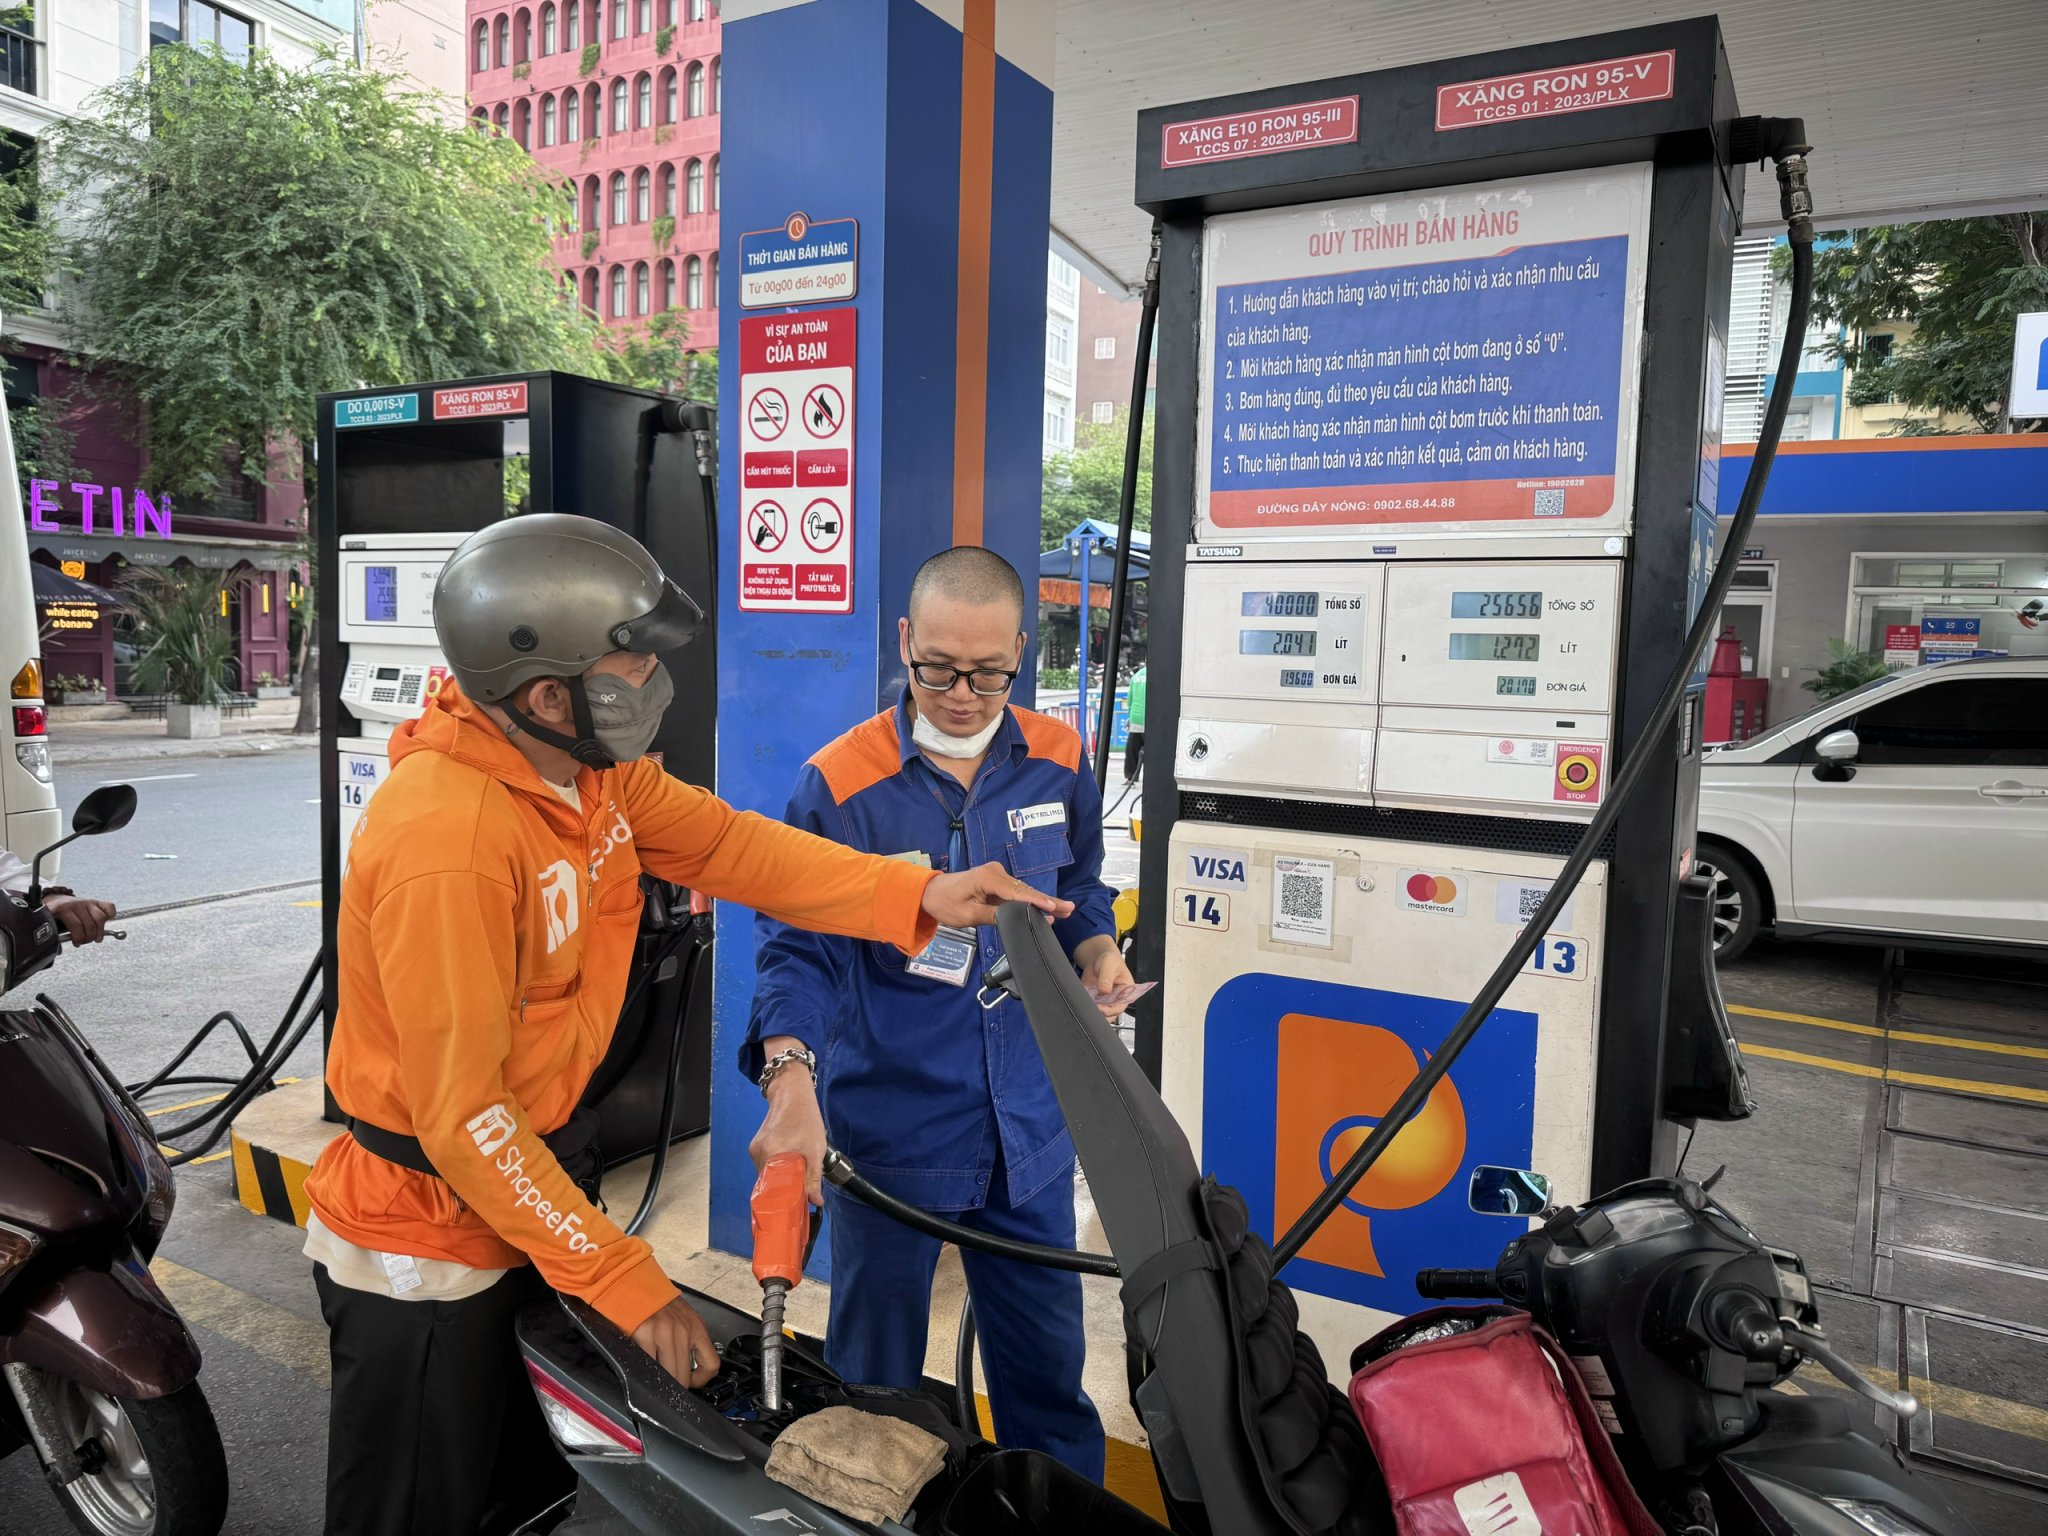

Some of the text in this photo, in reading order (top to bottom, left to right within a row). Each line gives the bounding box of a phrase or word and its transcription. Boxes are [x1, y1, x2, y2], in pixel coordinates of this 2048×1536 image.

[1456, 62, 1652, 108] XĂNG RON 95-V
[1474, 86, 1629, 120] TCCS 01 2023/PLX
[1179, 108, 1341, 145] XĂNG E10 RON 95-III
[1194, 127, 1322, 157] TCCS 07 2023/PLX
[1308, 208, 1519, 257] QUY TRÌNH BÁN HÀNG
[748, 241, 848, 266] THỜI GIAN BÁN HÀNG
[749, 273, 846, 294] Từ 00g00 đến 24g00
[1228, 296, 1237, 314] 1.
[1279, 286, 1299, 310] dẫn
[1302, 288, 1334, 307] khách
[1337, 284, 1365, 306] hàng
[1368, 281, 1387, 300] vào
[1390, 278, 1400, 302] vị
[1422, 274, 1450, 295] chào
[1453, 270, 1471, 292] hỏi
[1474, 268, 1488, 290] và
[1490, 266, 1512, 288] xác
[1516, 264, 1546, 289] nhận
[1550, 261, 1574, 283] nhu
[1576, 256, 1600, 280] cầu
[765, 320, 828, 338] VÌ SỰ AN TOÀN
[1227, 322, 1311, 347] của khách hàng.
[766, 340, 828, 364] CỦA BẠN
[1226, 360, 1235, 380] 2.
[1240, 358, 1259, 378] Mời
[1261, 355, 1292, 377] khách
[1296, 354, 1321, 376] hàng
[1324, 350, 1344, 372] xác
[1346, 348, 1374, 372] nhận
[1377, 346, 1400, 366] màn
[1404, 344, 1429, 364] hình
[1432, 341, 1450, 366] cột
[1454, 340, 1478, 361] bơm
[1482, 338, 1512, 361] đang
[1515, 334, 1523, 356] ở
[1526, 332, 1542, 354] số
[472, 391, 495, 402] RON
[496, 388, 520, 400] 95-V
[1225, 372, 1513, 412] 3. Bơm hàng đúng, đủ theo yêu cầu của khách hàng.
[347, 398, 406, 414] DO 0,001S-V
[1224, 424, 1232, 442] 4.
[1238, 422, 1256, 442] Mời
[1259, 419, 1290, 441] khách
[1292, 418, 1319, 442] hàng
[1322, 415, 1341, 436] xác
[1344, 414, 1370, 438] nhận
[1374, 413, 1398, 433] màn
[1401, 411, 1426, 431] hình
[1429, 410, 1446, 434] cột
[1450, 408, 1475, 429] bơm
[1512, 404, 1531, 425] khi
[1534, 402, 1569, 424] thanh
[1572, 400, 1604, 422] toán.
[1223, 436, 1588, 477] 5. Thực hiện thanh toán và xác nhận kết quả, cảm ơn khách hàng.
[30, 478, 172, 540] ETIN
[1257, 498, 1456, 514] ĐƯỜNG DÂY NÓNG: 0902.68.44.88
[1199, 547, 1241, 556] TATSUNO
[1265, 594, 1316, 615] 40000
[1480, 594, 1539, 617] 25656
[1335, 636, 1348, 649] LÍT
[1560, 642, 1578, 654] LÍT
[1285, 672, 1314, 686] 19600
[1342, 674, 1357, 685] GIÁ
[1499, 678, 1535, 694] 20170
[1570, 682, 1587, 692] GIÁ
[1560, 745, 1601, 754] EMERGENCY
[350, 762, 376, 779] VISA
[344, 784, 362, 804] 16
[1190, 855, 1245, 882] VISA
[1184, 894, 1220, 925] 14
[1408, 902, 1454, 912] mastercard
[1534, 938, 1576, 974] 13
[496, 1145, 600, 1255] ShopeeFoo
